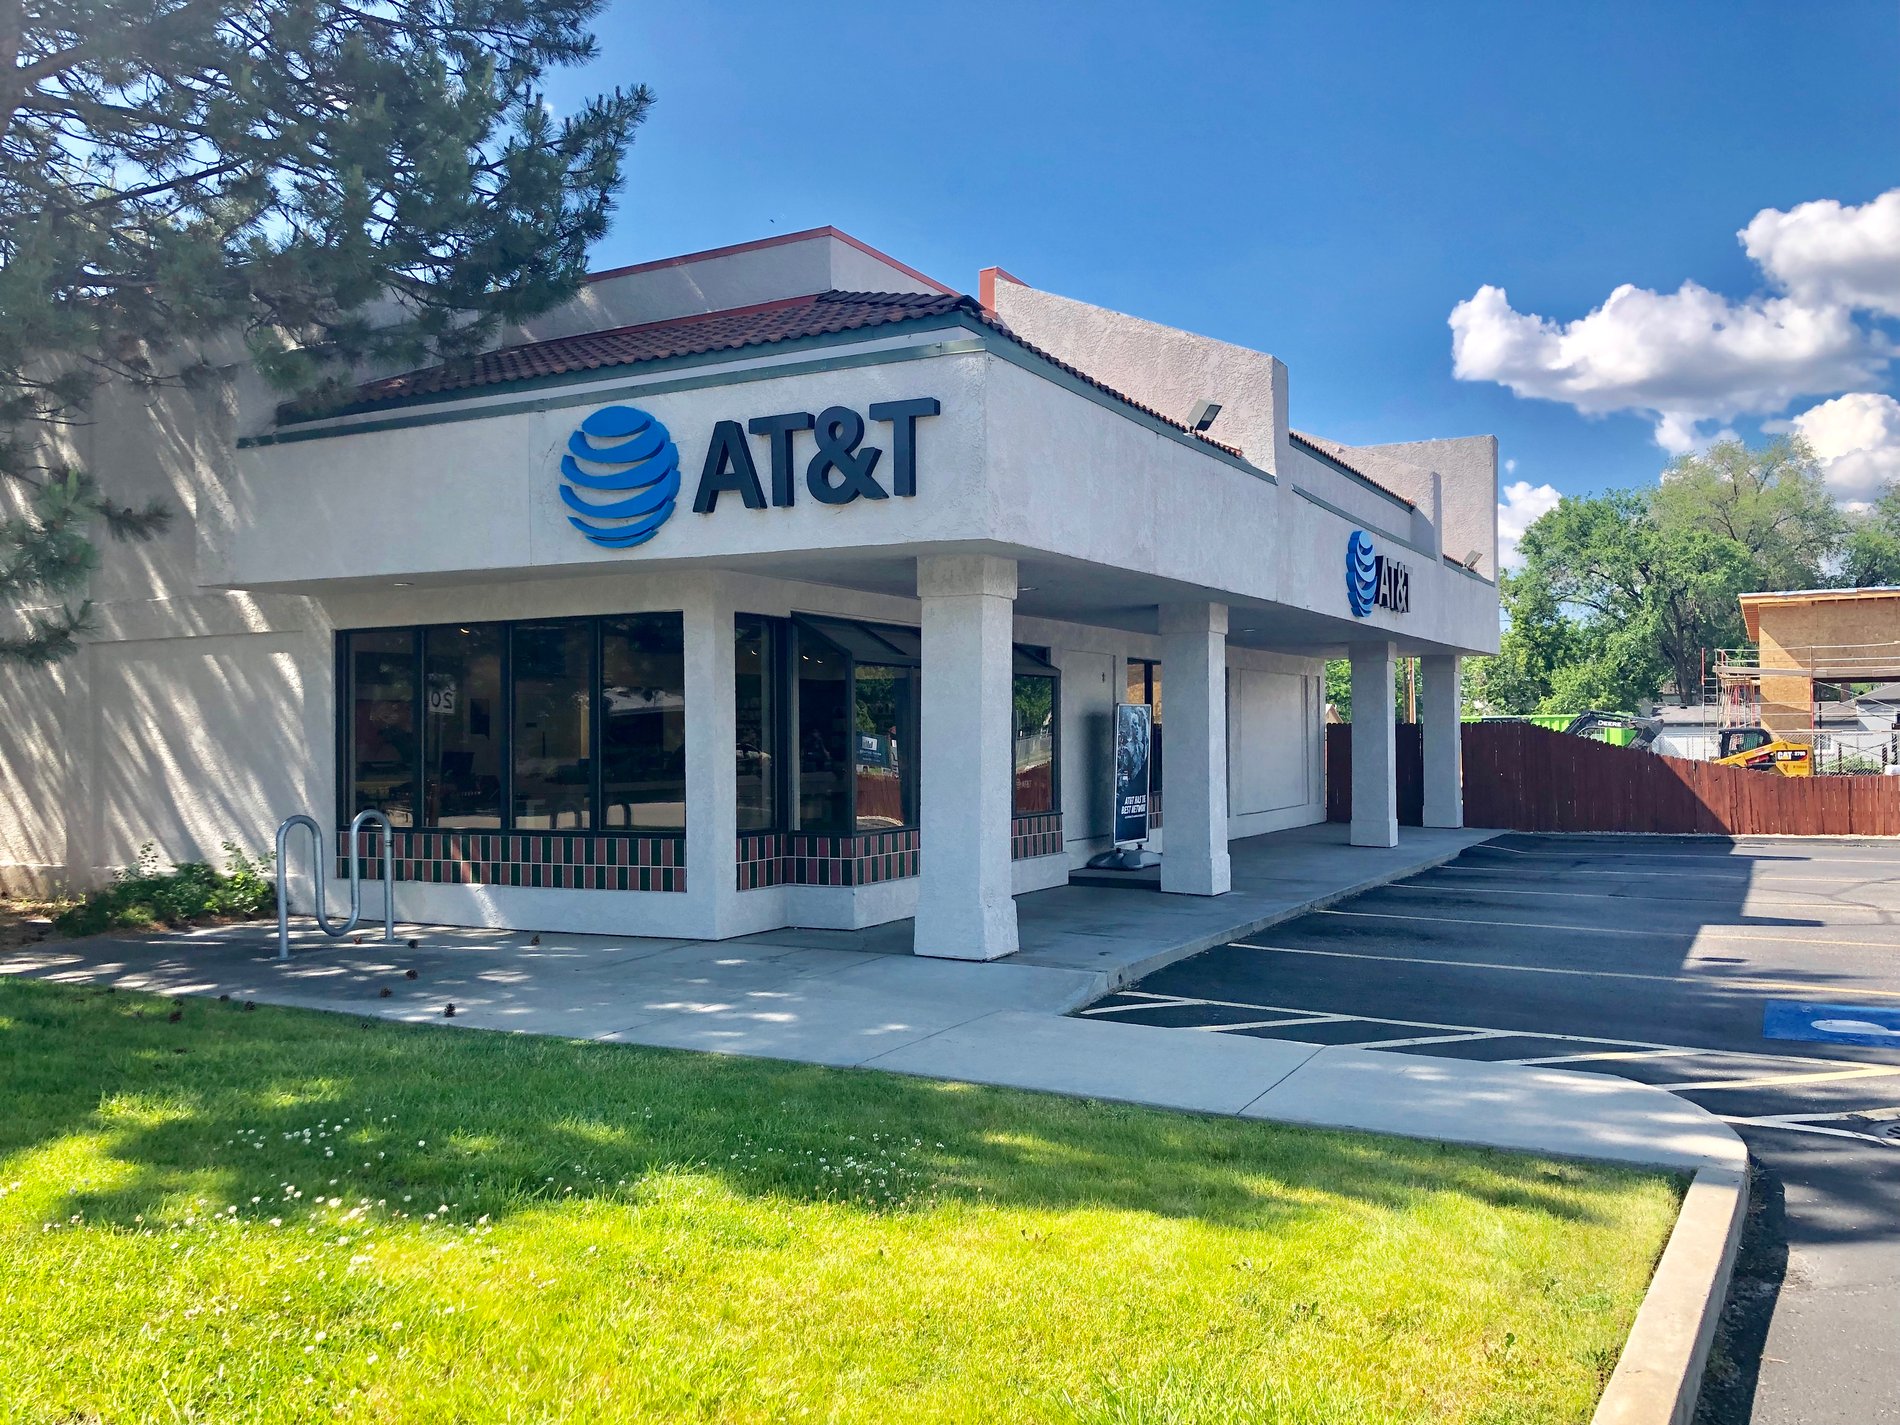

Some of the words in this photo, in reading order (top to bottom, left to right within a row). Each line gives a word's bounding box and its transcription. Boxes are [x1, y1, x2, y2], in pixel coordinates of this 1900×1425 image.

[692, 397, 941, 513] AT&T
[1374, 555, 1414, 613] AT&T
[1598, 719, 1622, 727] DEERE
[1777, 751, 1792, 760] CAT
[1121, 805, 1131, 814] BEST
